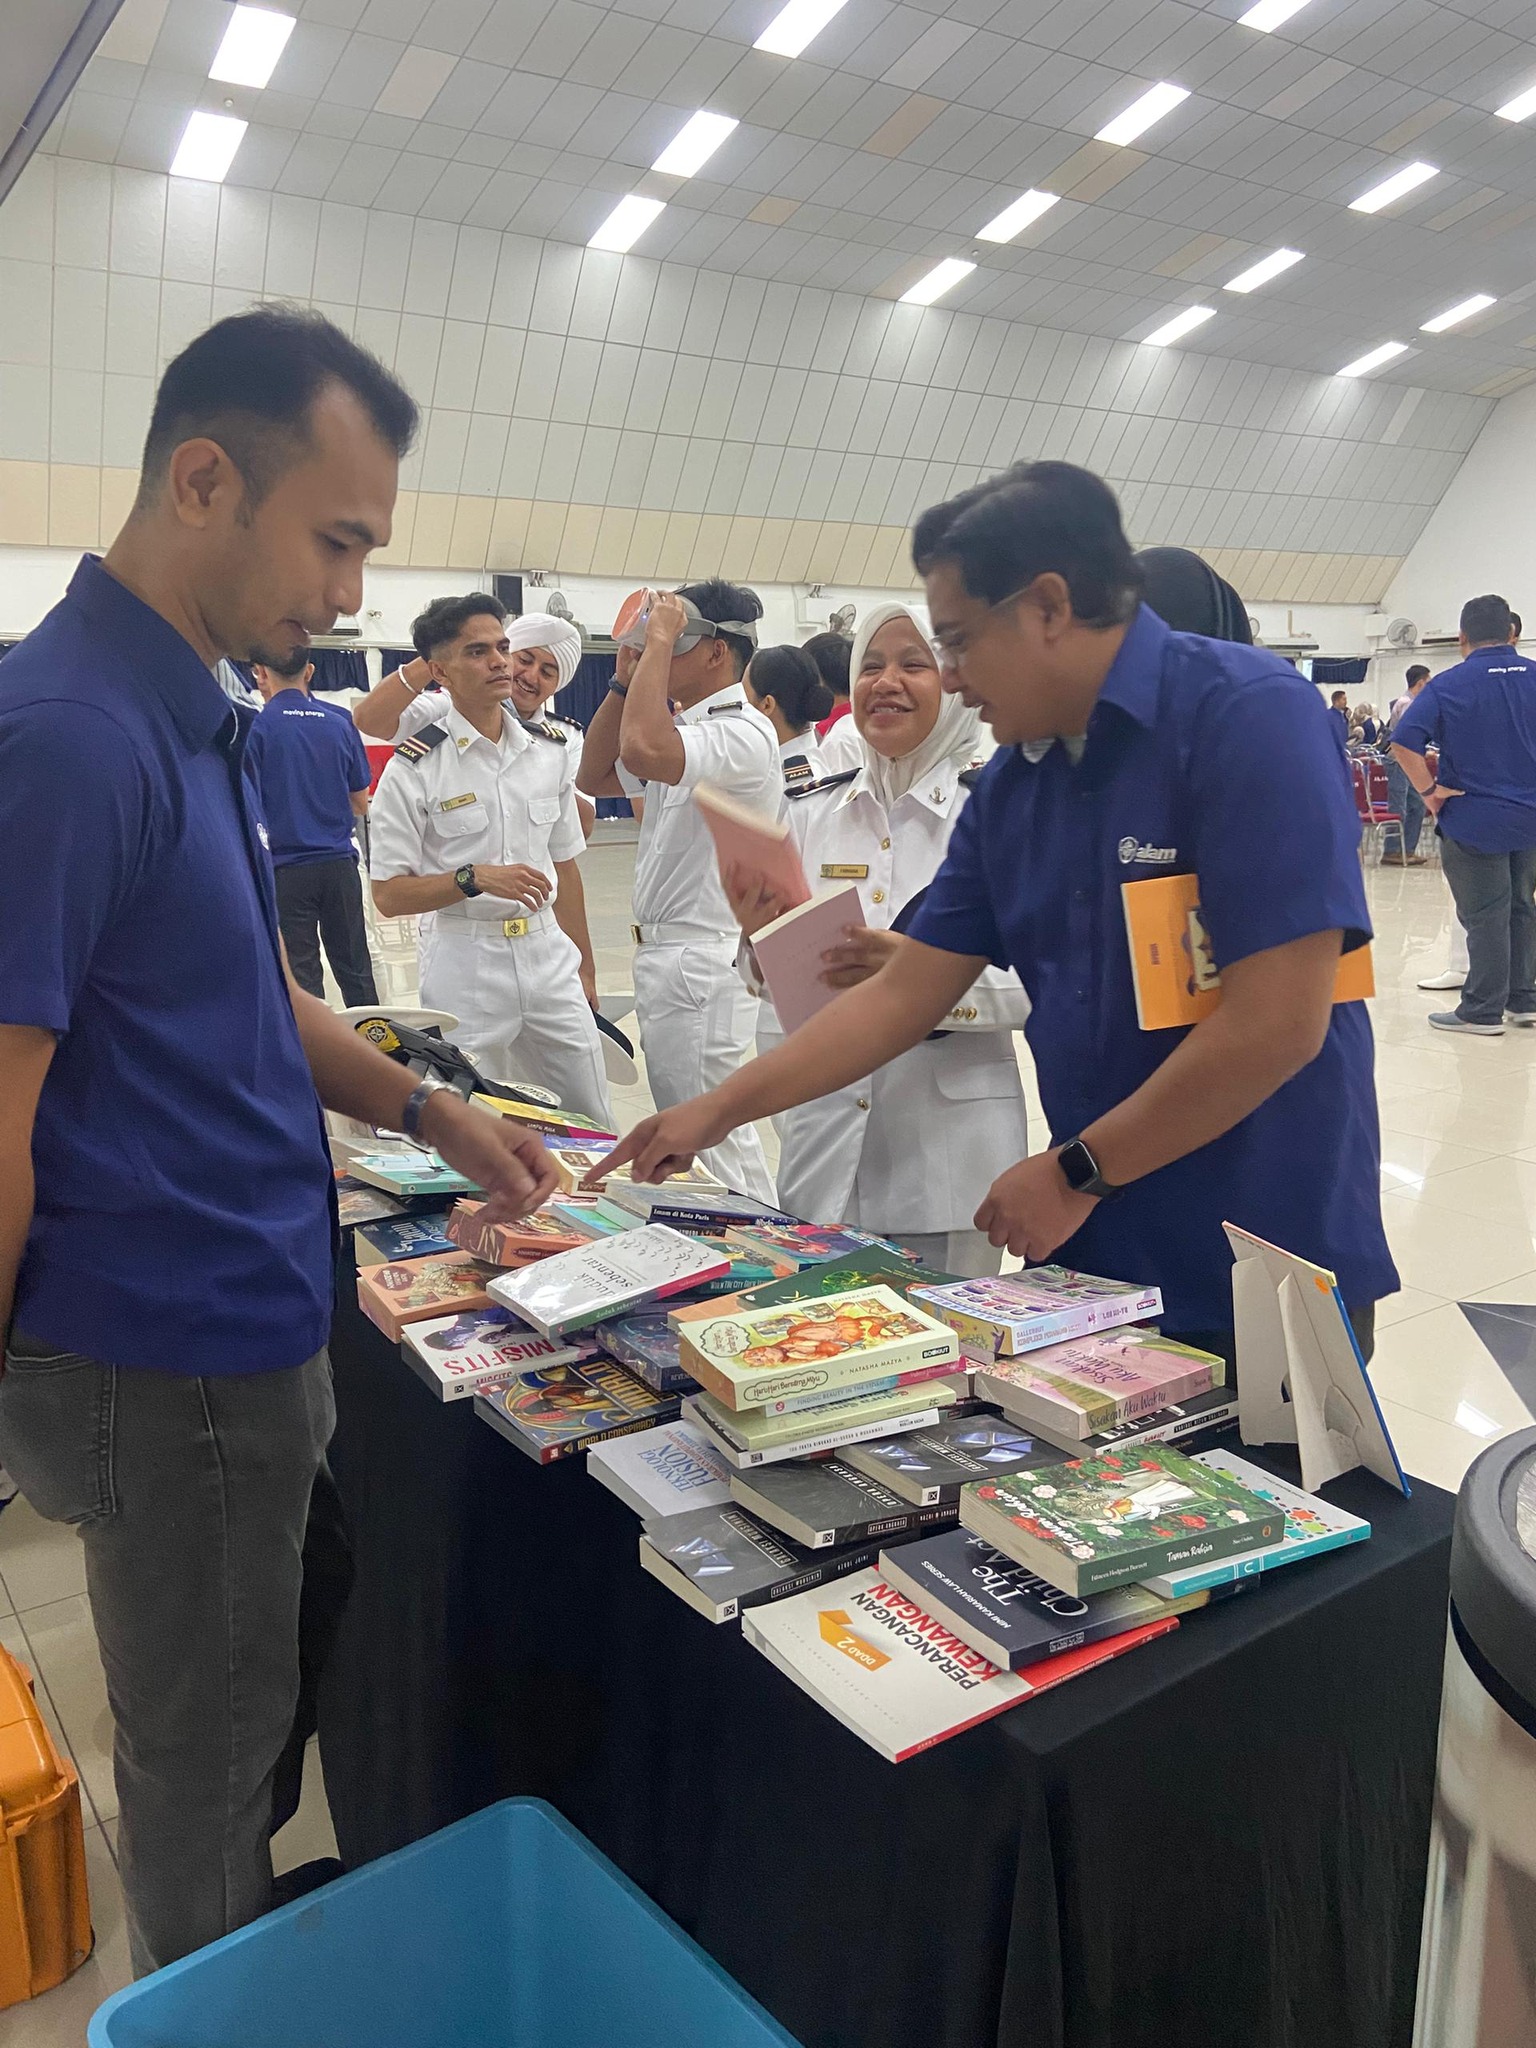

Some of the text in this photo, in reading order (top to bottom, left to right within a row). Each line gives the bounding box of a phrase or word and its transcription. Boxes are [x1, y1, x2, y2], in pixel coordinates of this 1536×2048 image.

[282, 709, 325, 718] moving energy
[397, 744, 418, 759] ALAM
[789, 770, 809, 779] ALAM
[1137, 842, 1177, 857] alam
[653, 1208, 671, 1218] Imam
[672, 1210, 679, 1218] di
[680, 1211, 694, 1220] Kota
[694, 1212, 710, 1222] Paris
[579, 1270, 617, 1298] duduk
[581, 1254, 634, 1289] sebentar
[443, 1339, 556, 1376] MISFITS
[849, 1357, 903, 1374] NATASHA MAZYA
[1055, 1357, 1114, 1384] Sisakan
[1063, 1348, 1141, 1382] Aku Waktu
[580, 1362, 662, 1410] WORLD
[780, 1378, 807, 1394] Bersama
[1088, 1391, 1167, 1431] Sisakan Aku Waktu
[607, 1417, 656, 1442] CONSPIRACY
[638, 1450, 690, 1492] TEKNOLOGI
[662, 1443, 717, 1488] FUSION
[868, 1487, 900, 1508] OPERA
[1166, 1546, 1190, 1562] Taman
[920, 1560, 946, 1581] SERIES
[971, 1565, 1025, 1606] The
[957, 1588, 994, 1619] KAMARIAH
[866, 1582, 1001, 1681] KEWANGAN
[992, 1614, 1011, 1629] MIMI
[835, 1636, 850, 1650] 2
[849, 1592, 981, 1691] PERANCANGAN
